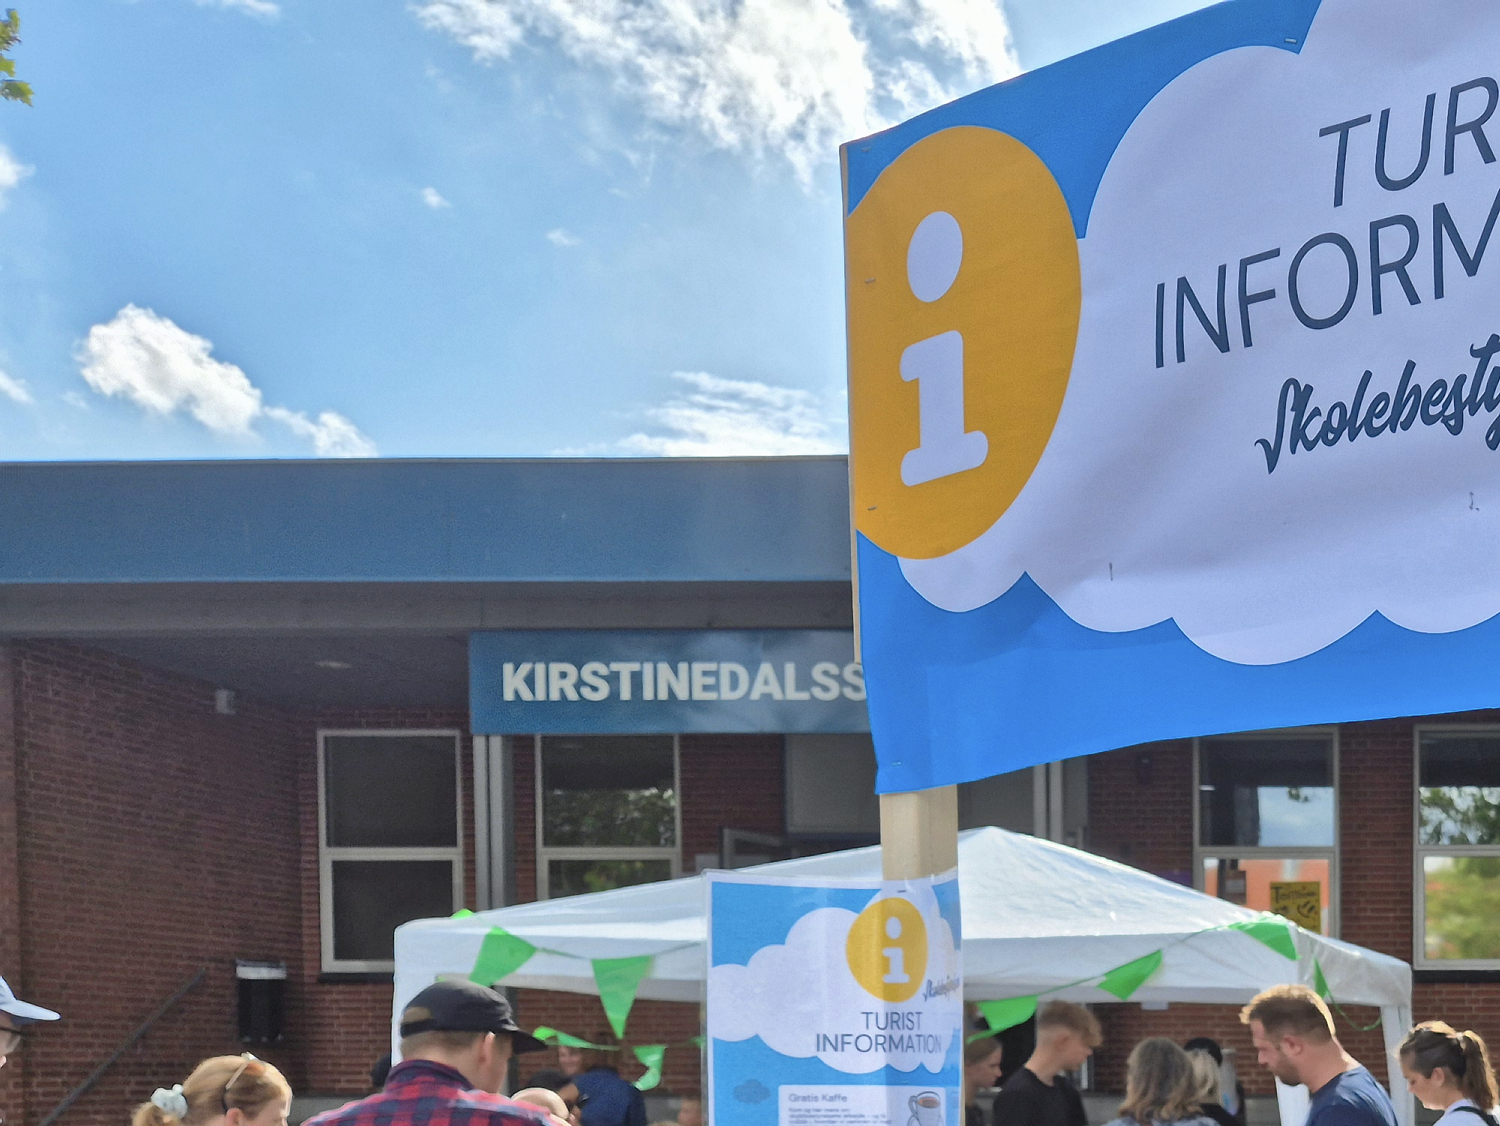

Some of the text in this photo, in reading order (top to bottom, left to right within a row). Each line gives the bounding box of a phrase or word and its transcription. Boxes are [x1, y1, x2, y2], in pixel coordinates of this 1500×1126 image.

[502, 661, 868, 701] KIRSTINEDALSS
[861, 1011, 923, 1031] TURIST
[816, 1033, 942, 1053] INFORMATION
[788, 1092, 848, 1103] Gratis Kaffe
